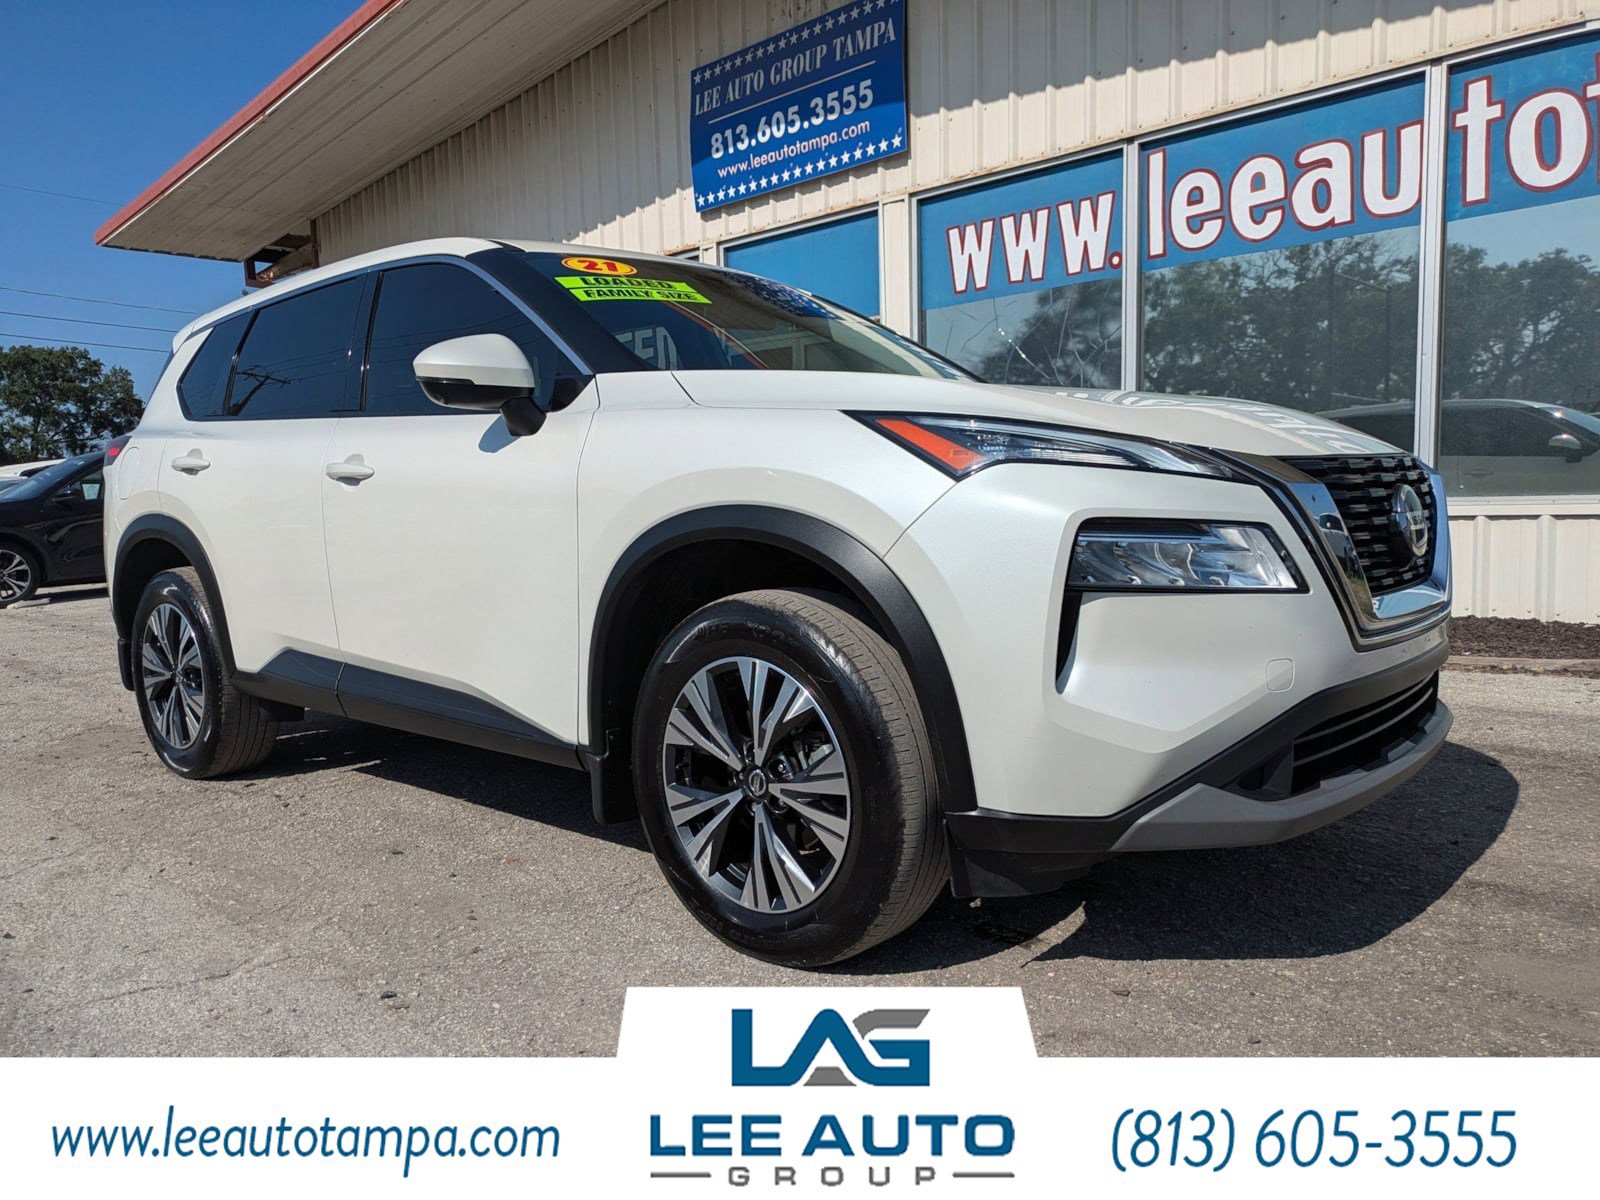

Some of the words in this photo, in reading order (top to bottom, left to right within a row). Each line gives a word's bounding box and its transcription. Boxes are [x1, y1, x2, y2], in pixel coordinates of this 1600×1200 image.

[694, 85, 721, 117] LEE
[724, 69, 765, 103] AUTO
[769, 44, 827, 87] GROUP
[833, 17, 897, 62] TAMPA
[710, 79, 874, 160] 813.605.3555
[717, 118, 871, 179] www.leeautotampa.com
[577, 259, 620, 273] 21
[579, 276, 672, 289] LOADED
[583, 288, 651, 299] FAMILY
[656, 290, 697, 300] SIZE
